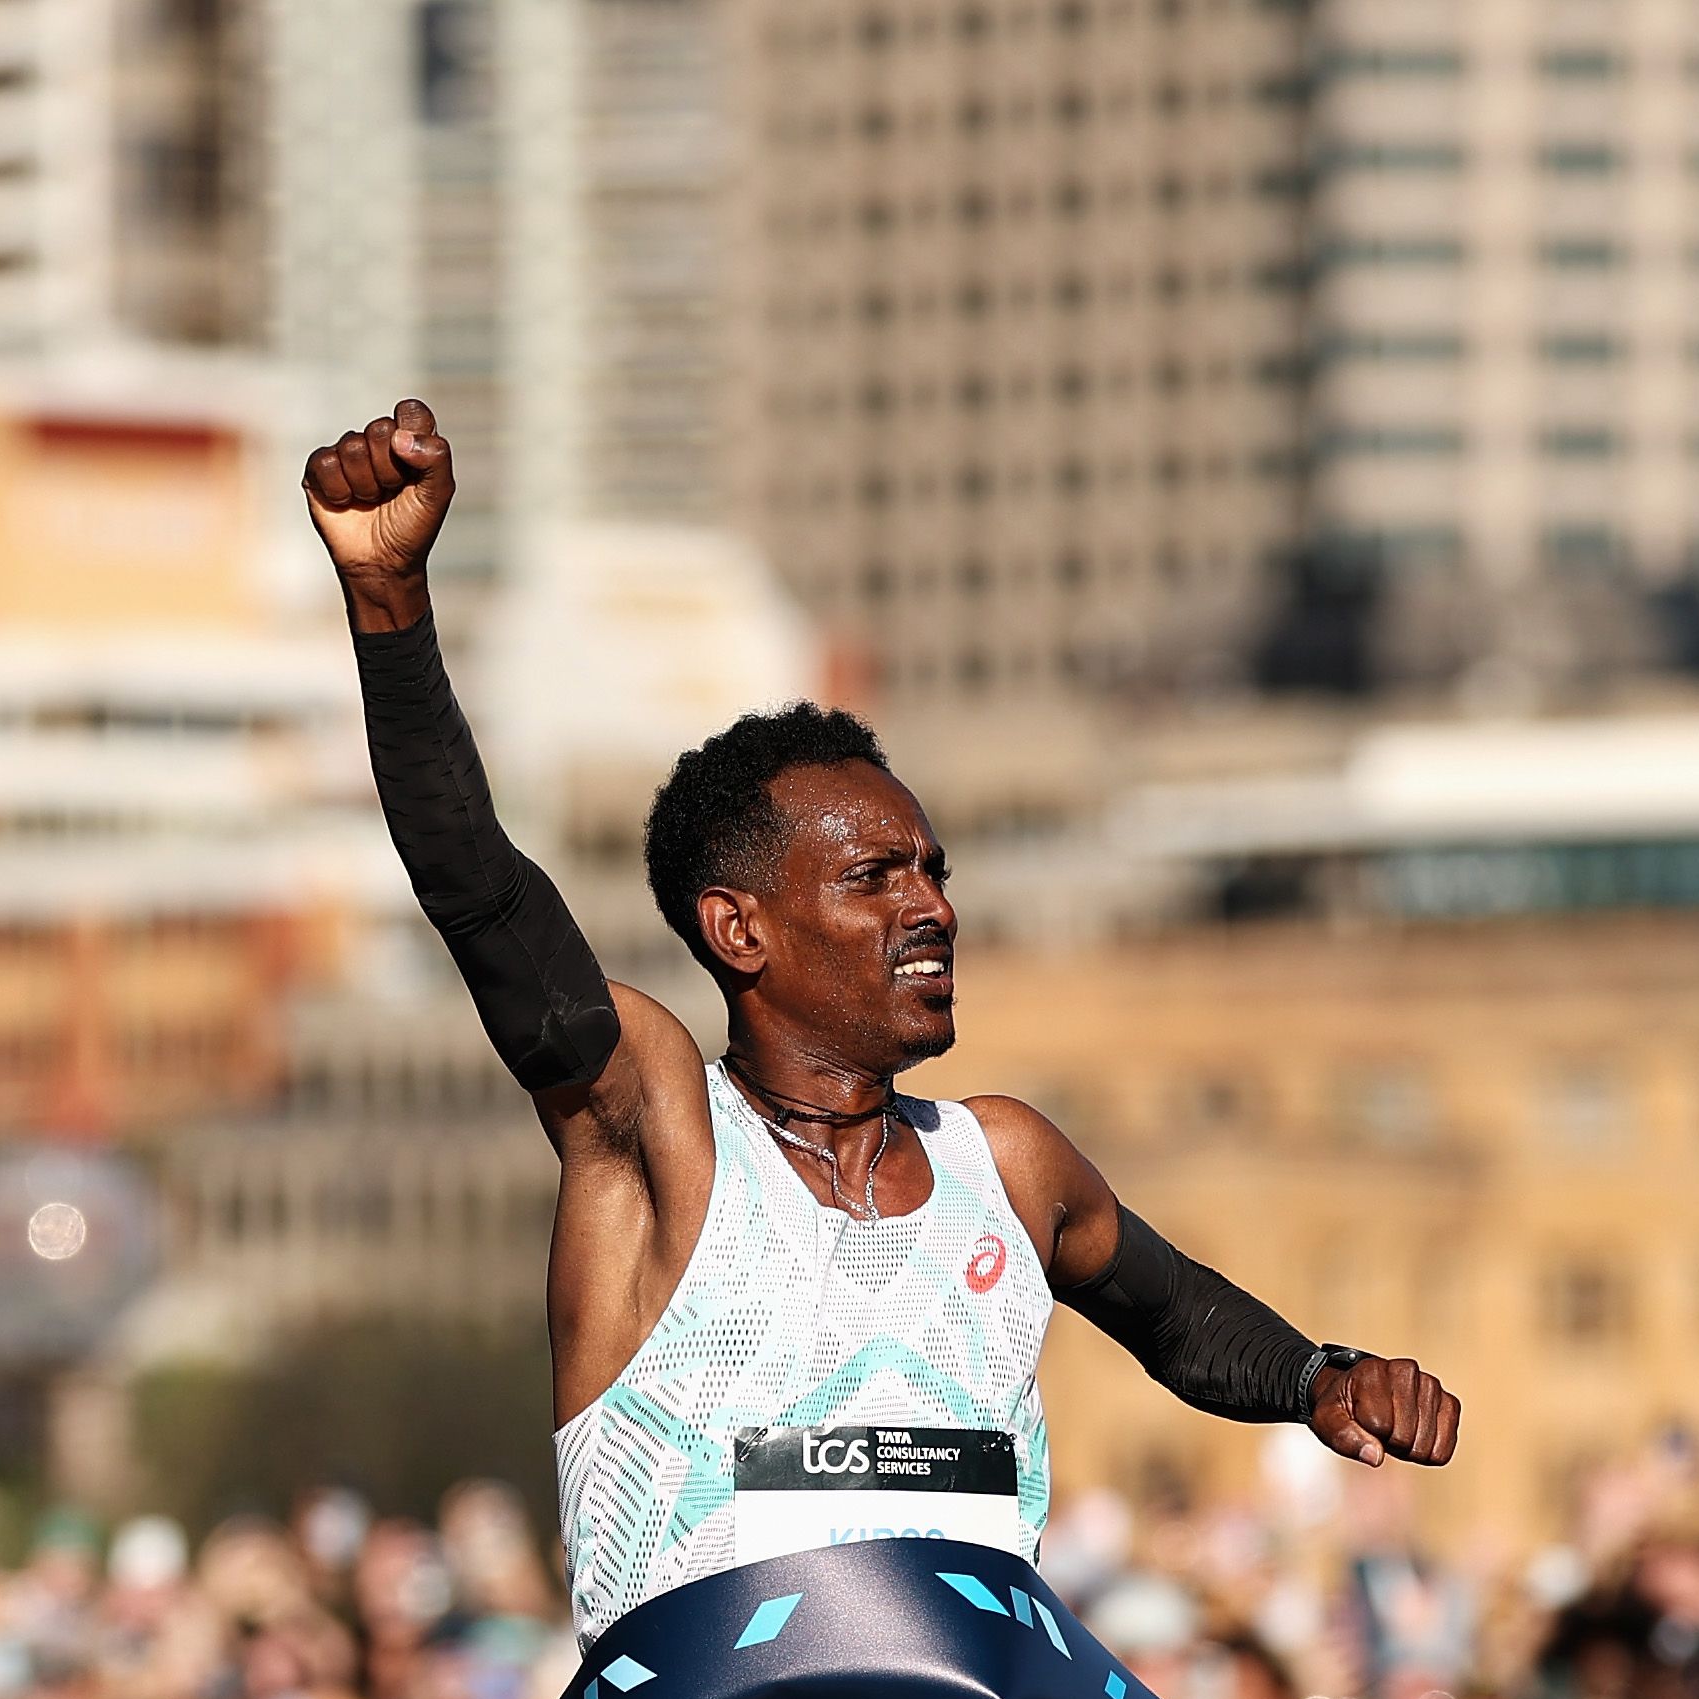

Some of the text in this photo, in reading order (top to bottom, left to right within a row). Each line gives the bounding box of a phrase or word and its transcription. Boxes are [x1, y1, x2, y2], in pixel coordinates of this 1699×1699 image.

[876, 1431, 912, 1444] TATA
[803, 1431, 870, 1474] tcs
[876, 1446, 961, 1461] CONSULTANCY
[876, 1461, 931, 1475] SERVICES
